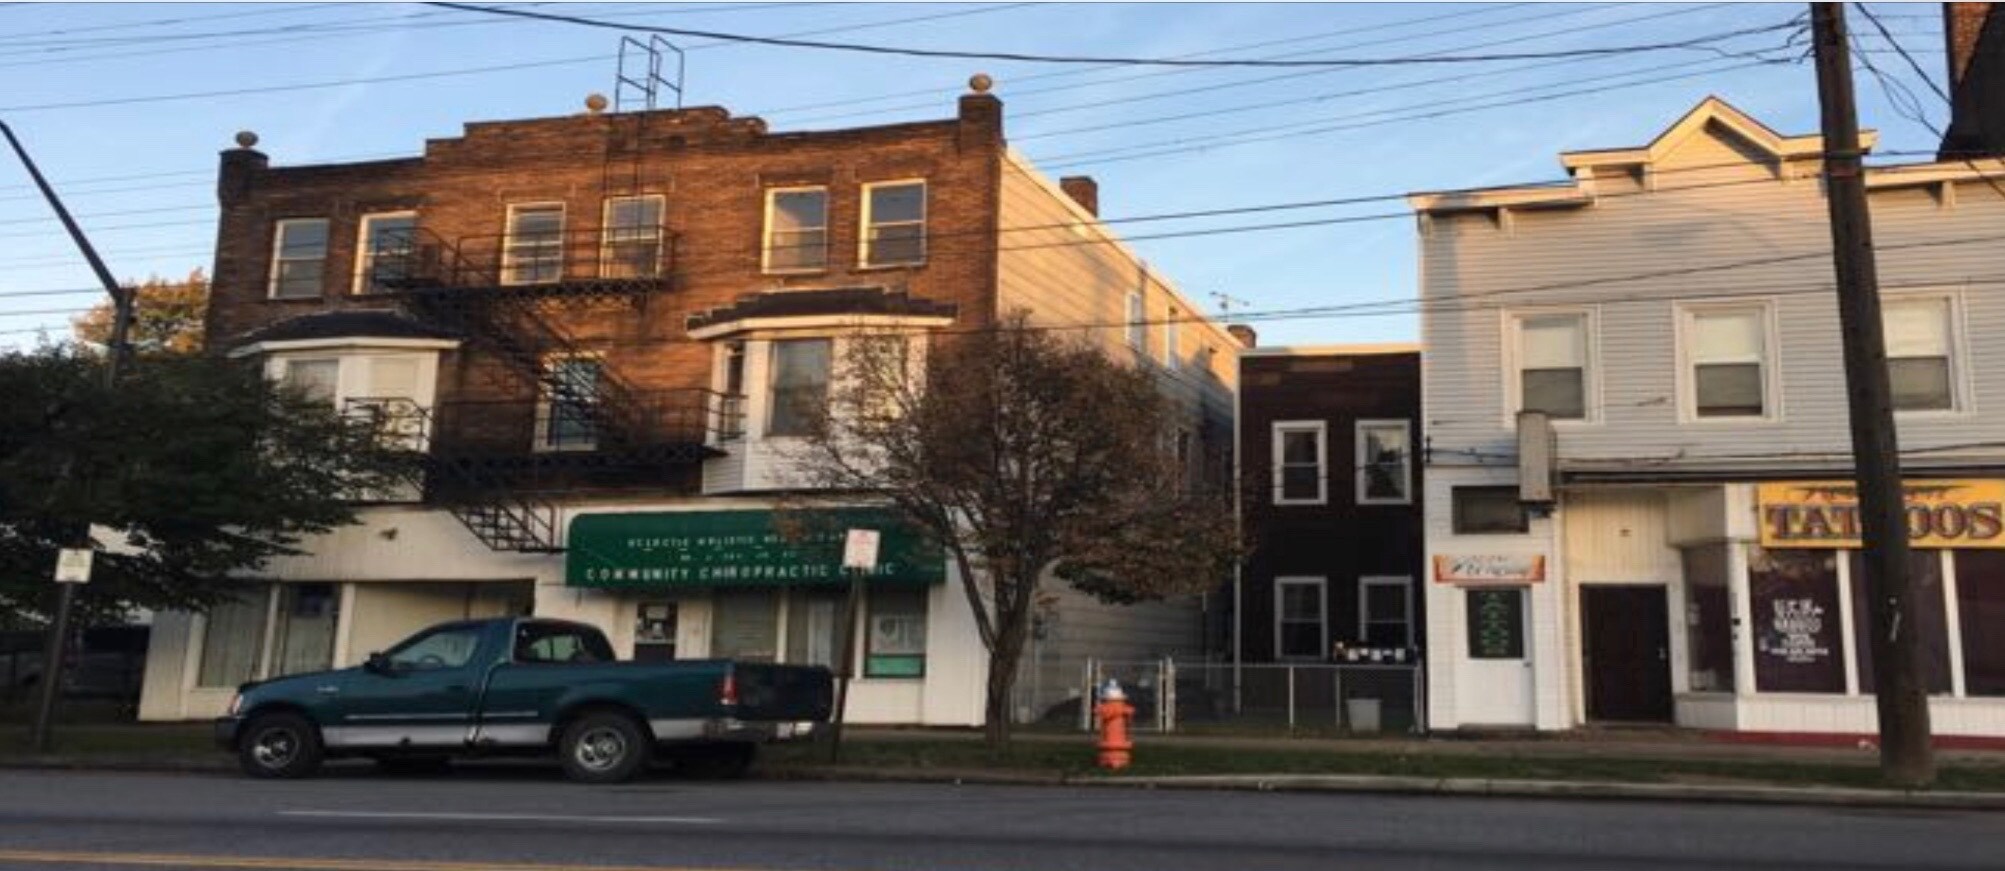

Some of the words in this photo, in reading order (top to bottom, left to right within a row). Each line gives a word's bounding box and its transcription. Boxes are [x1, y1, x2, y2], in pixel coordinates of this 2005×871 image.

[1765, 501, 2002, 541] TATOOS
[586, 566, 690, 581] COMMUNITY
[699, 564, 829, 580] CHIROPRACTIC
